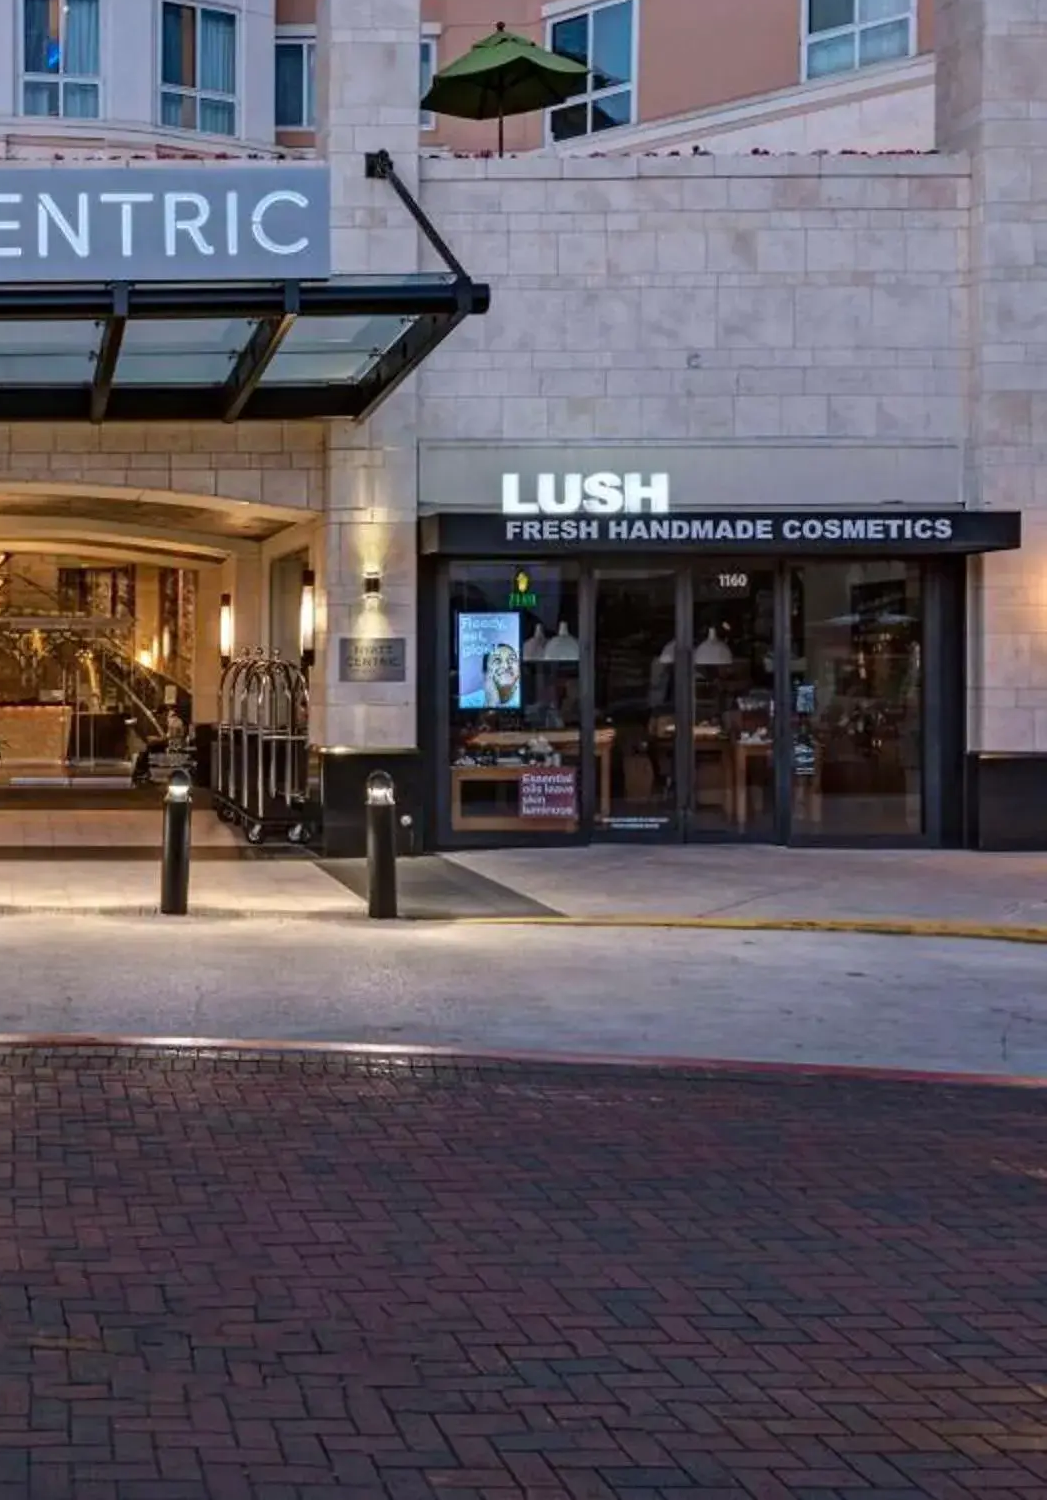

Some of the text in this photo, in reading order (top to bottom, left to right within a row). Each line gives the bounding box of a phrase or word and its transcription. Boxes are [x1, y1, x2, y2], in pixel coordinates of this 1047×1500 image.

[501, 472, 669, 513] LUSH
[505, 518, 953, 540] FRESH HANDMADE COSMETICS
[718, 573, 748, 588] 1160
